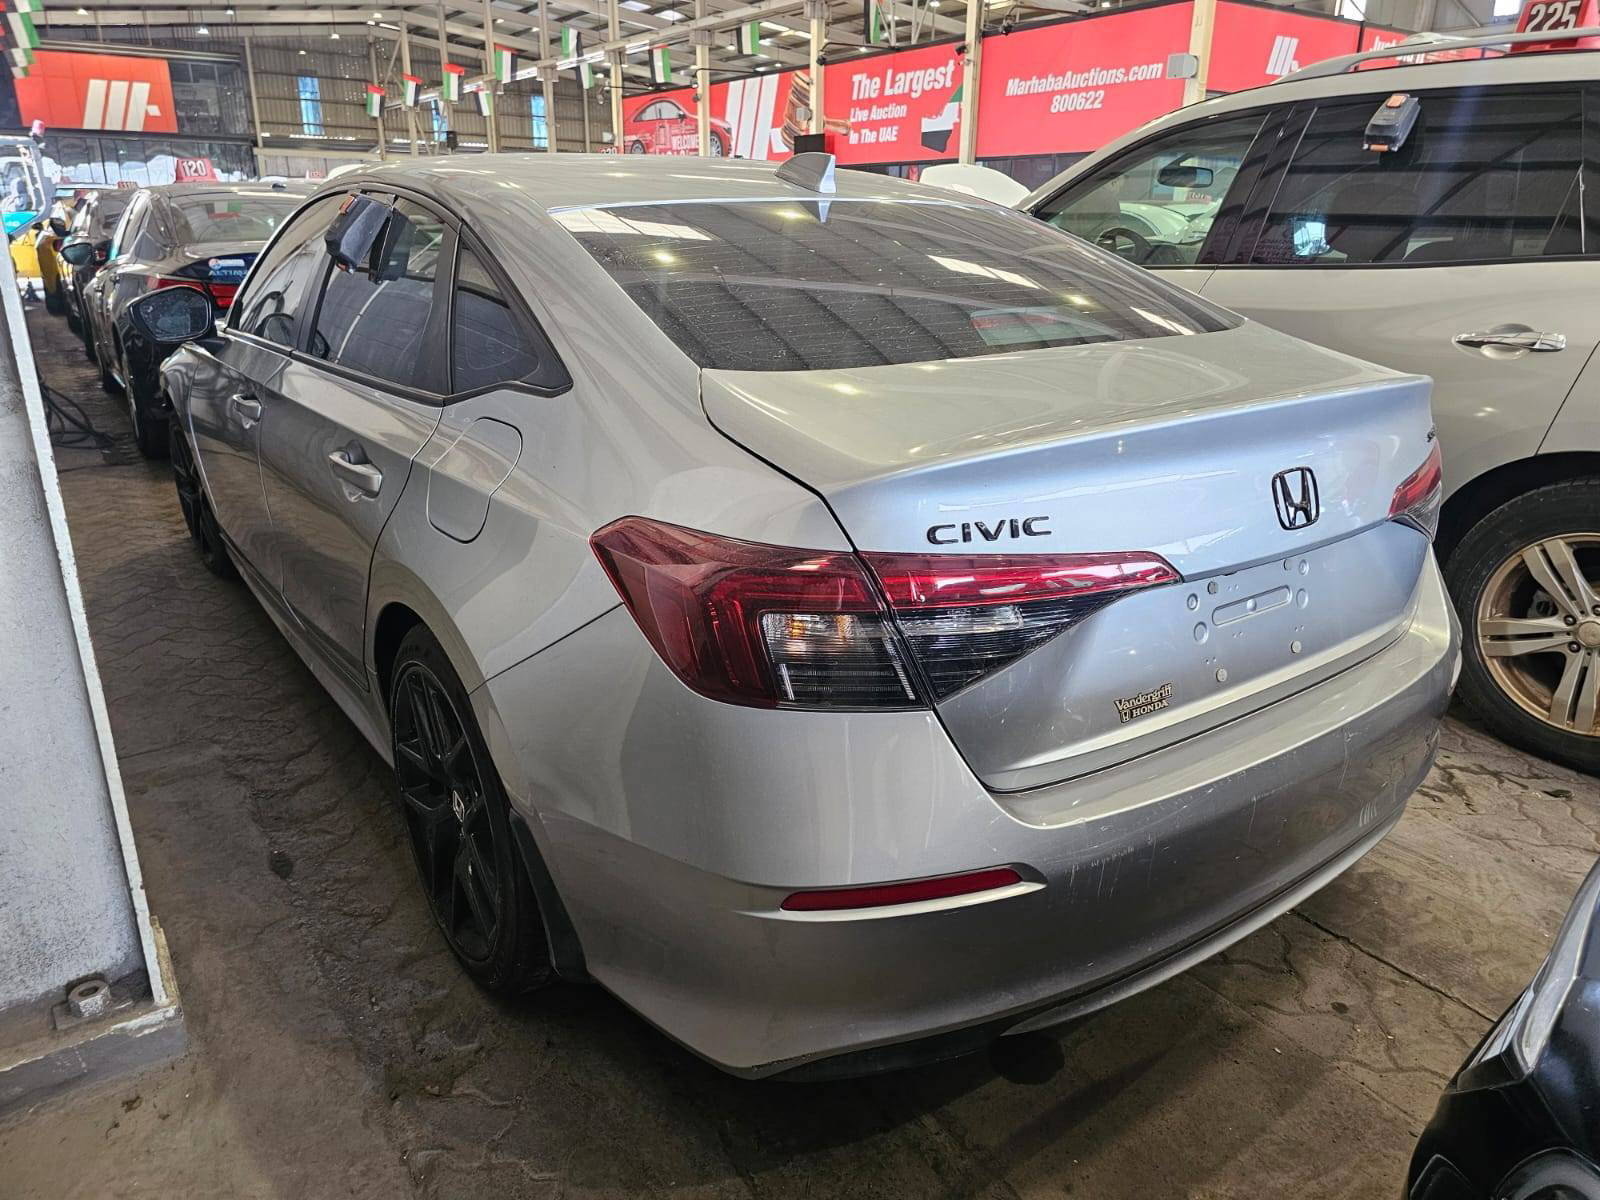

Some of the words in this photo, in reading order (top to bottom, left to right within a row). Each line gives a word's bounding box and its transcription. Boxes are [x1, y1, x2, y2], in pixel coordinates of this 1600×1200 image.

[1525, 1, 1581, 33] 225
[851, 72, 881, 101] The
[884, 59, 955, 99] Largest
[1005, 63, 1163, 97] MarhabaAuctions.com
[850, 107, 869, 123] Live
[869, 103, 907, 121] Auction
[1050, 90, 1105, 113] 800622
[849, 130, 859, 145] In
[860, 128, 877, 144] The
[878, 126, 899, 142] UAE
[183, 160, 208, 177] 120
[926, 516, 1052, 545] CIVIC
[1114, 683, 1173, 711] Vandergriff
[1132, 699, 1169, 718] HONDA
